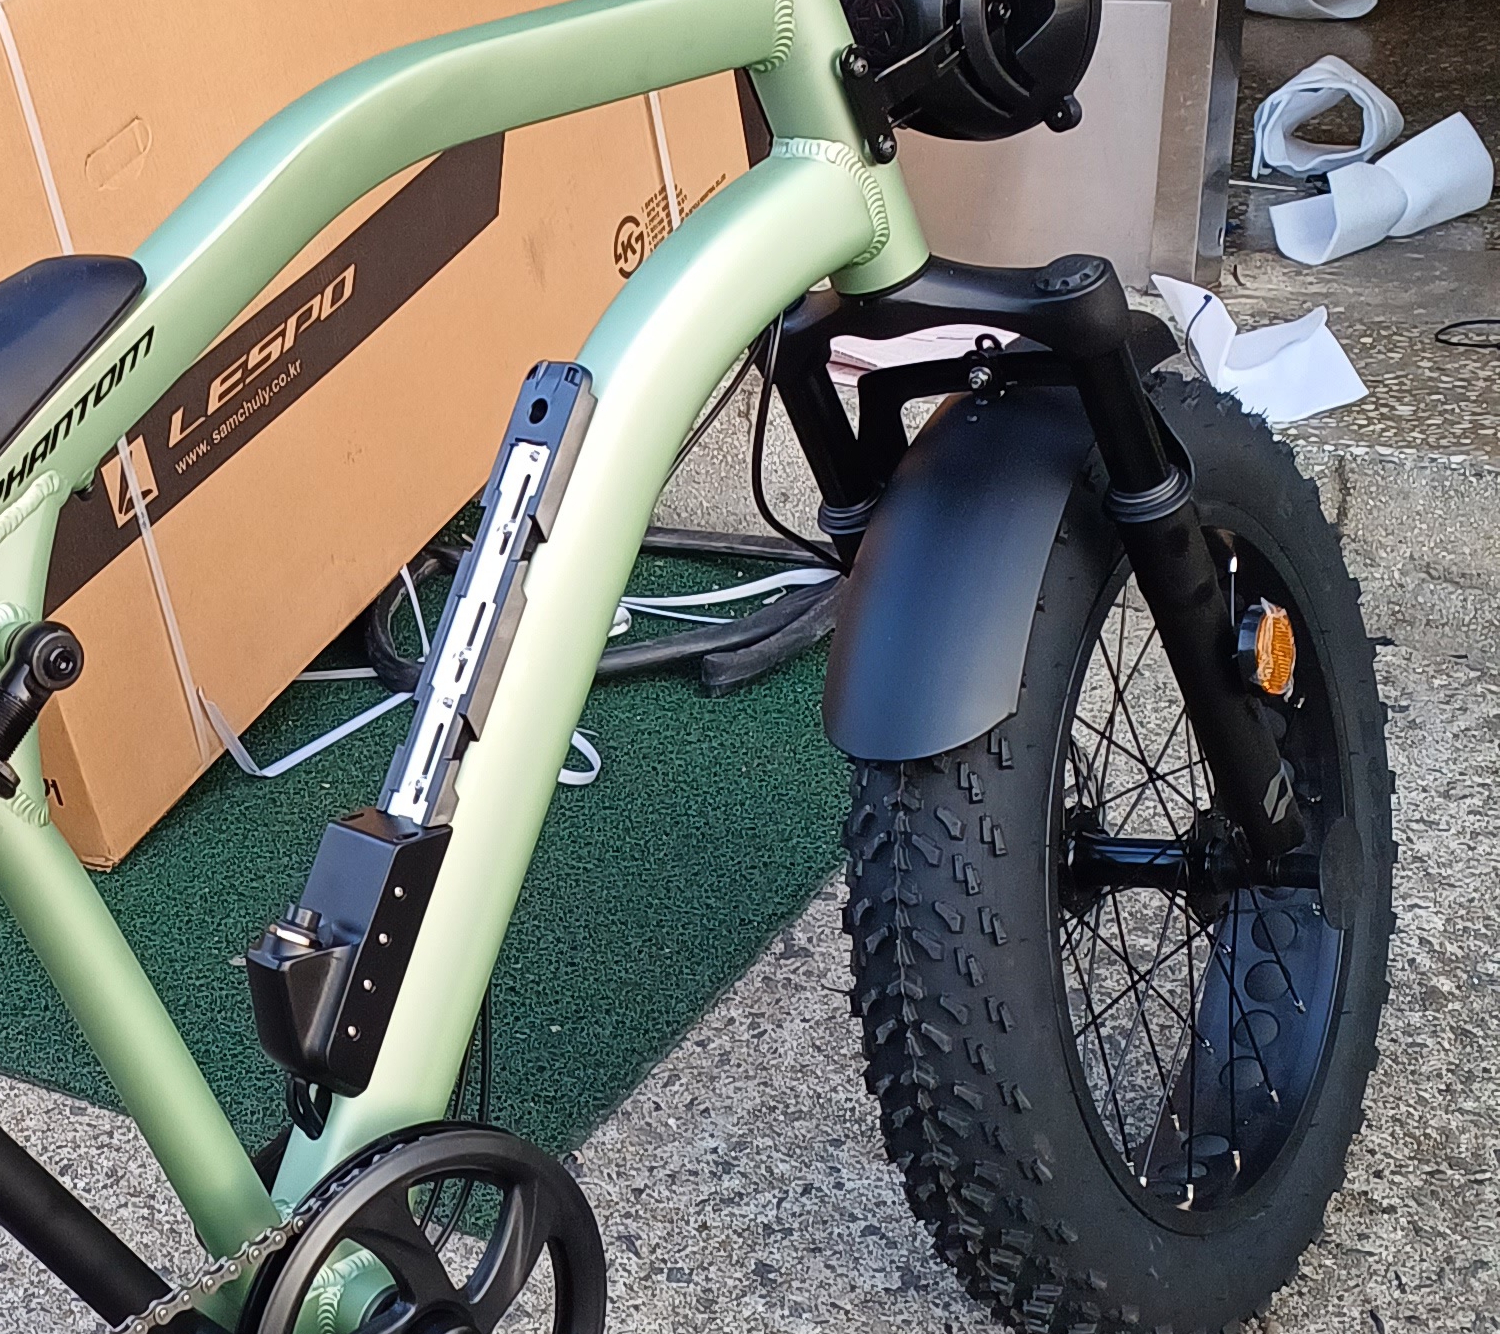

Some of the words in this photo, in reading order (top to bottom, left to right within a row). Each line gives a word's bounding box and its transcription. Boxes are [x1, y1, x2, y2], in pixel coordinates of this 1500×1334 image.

[168, 263, 356, 448] LESPO
[174, 436, 211, 475] www.
[211, 357, 302, 445] samchuly.co.kr
